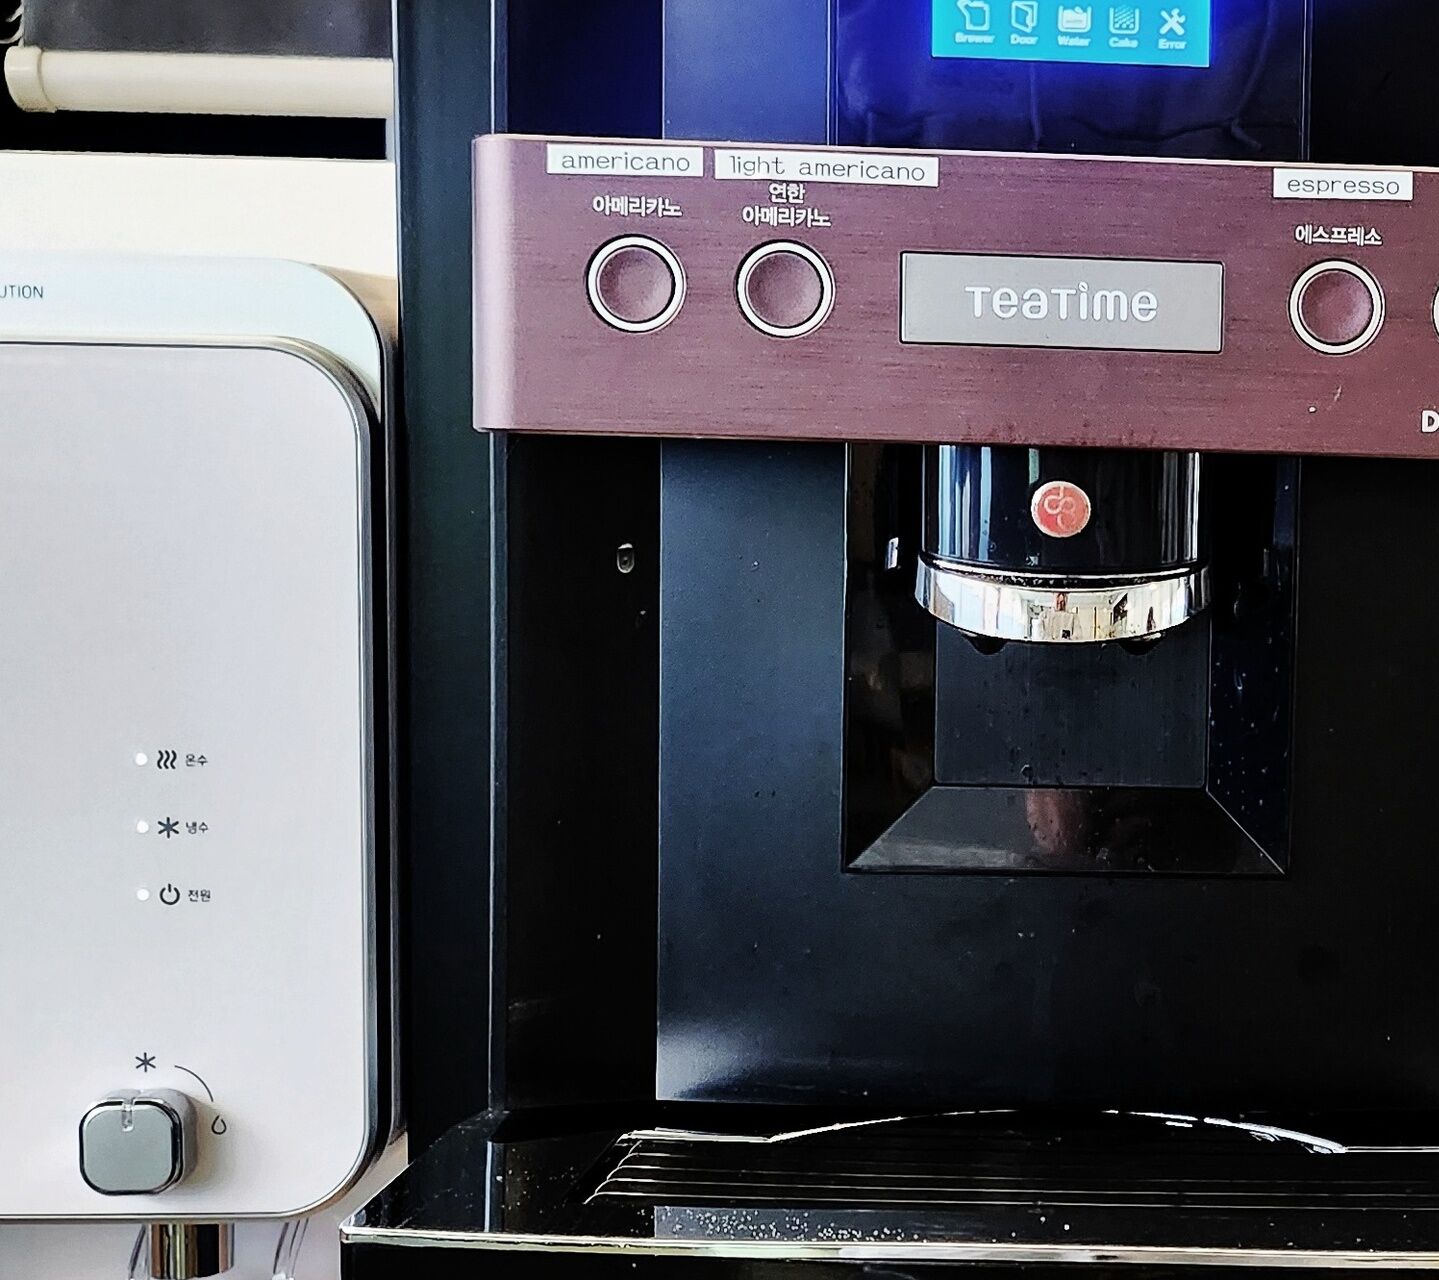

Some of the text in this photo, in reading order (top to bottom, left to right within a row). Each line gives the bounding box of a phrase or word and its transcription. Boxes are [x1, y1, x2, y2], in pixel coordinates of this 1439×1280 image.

[955, 31, 995, 44] Brewer
[1010, 33, 1039, 45] Door
[1057, 35, 1091, 47] Water
[1109, 37, 1139, 48] Cake
[1158, 38, 1187, 50] Error
[561, 151, 691, 172] americano
[729, 154, 926, 182] light americano
[768, 182, 805, 204] 연한
[1286, 179, 1400, 198] espresso
[592, 194, 683, 218] 아메리카노
[742, 205, 832, 228] 아메리카노
[1295, 224, 1383, 247] 에스프레소
[185, 753, 208, 767] 온수
[185, 821, 209, 835] 냉수
[187, 889, 211, 903] 전원
